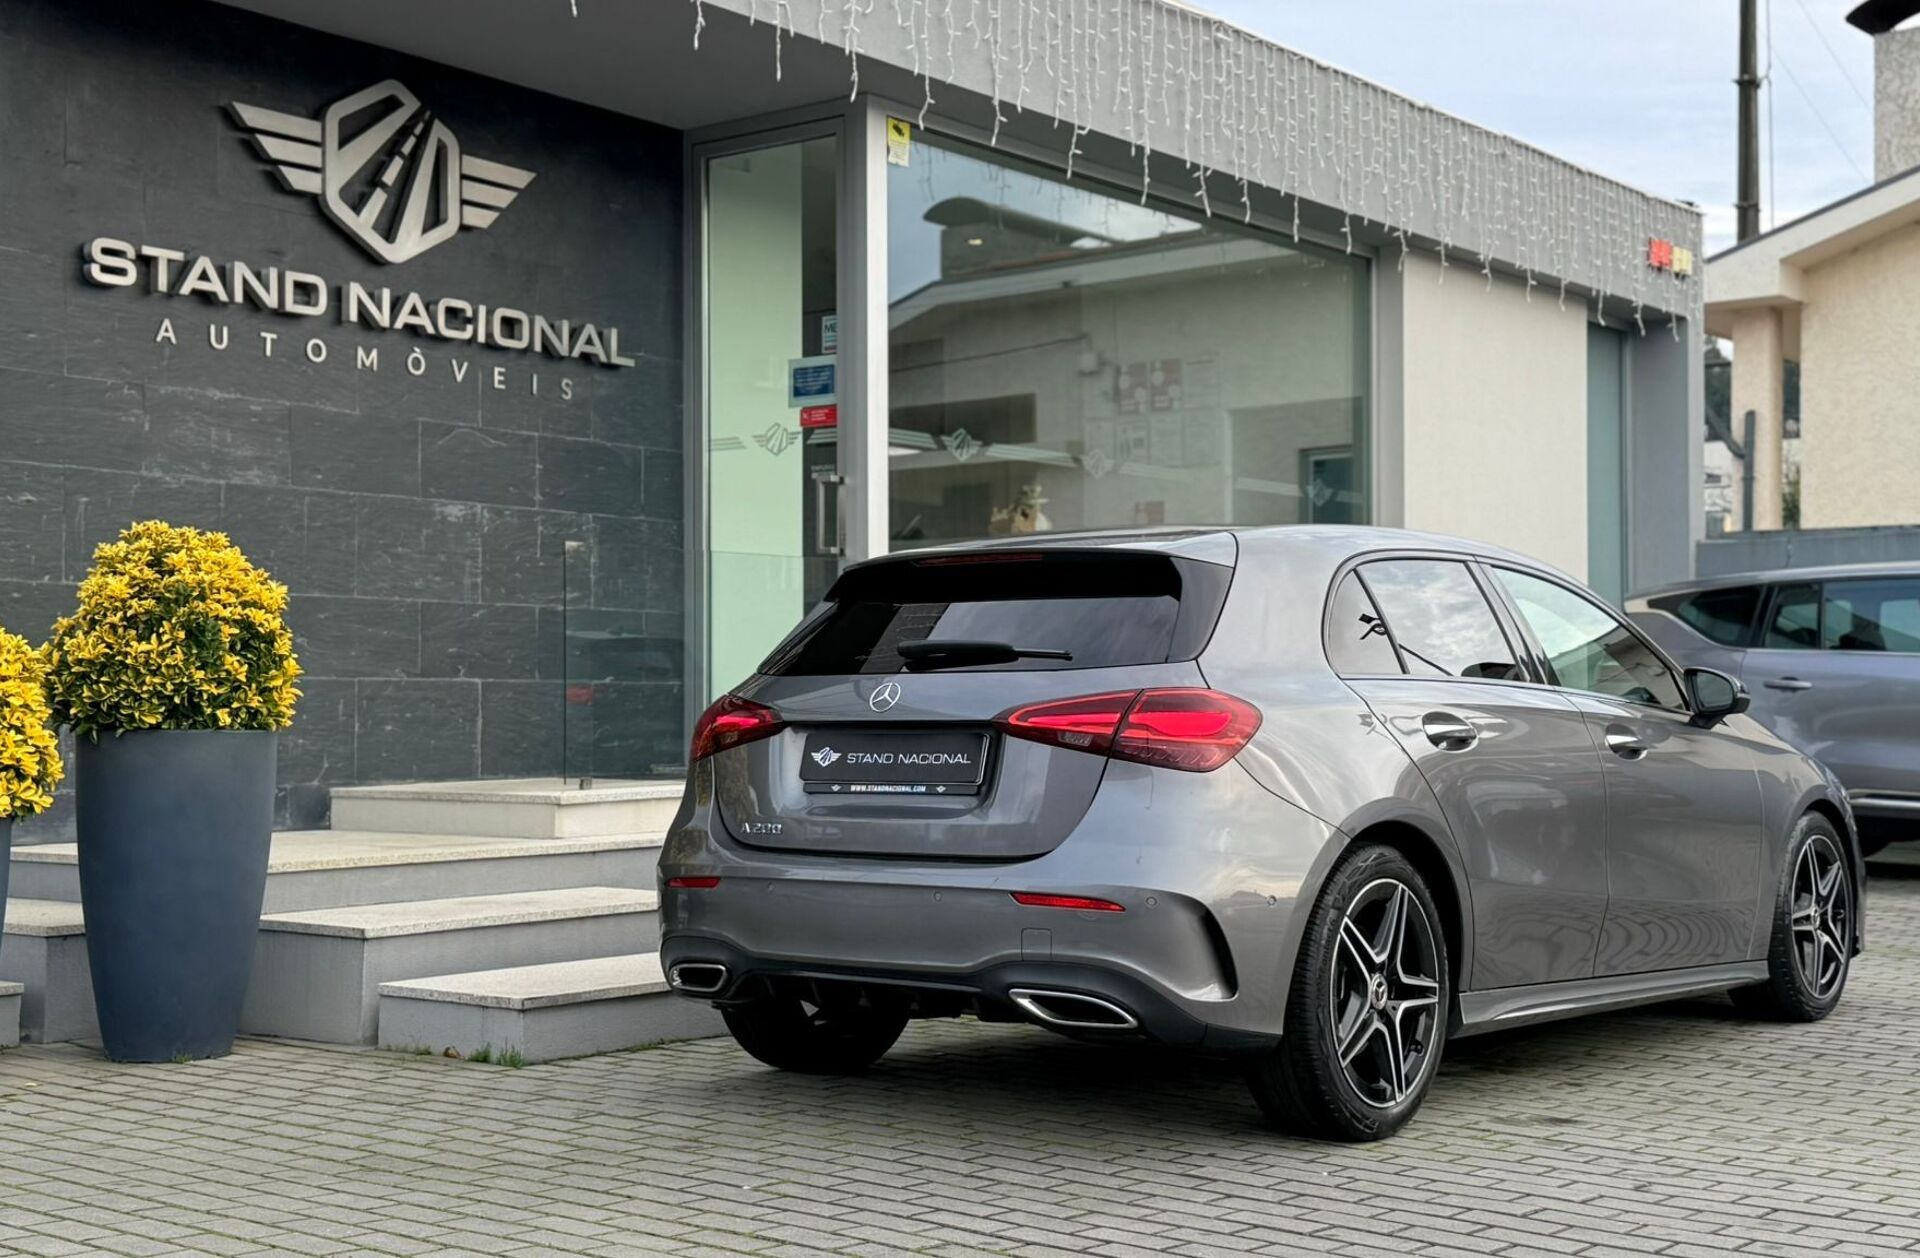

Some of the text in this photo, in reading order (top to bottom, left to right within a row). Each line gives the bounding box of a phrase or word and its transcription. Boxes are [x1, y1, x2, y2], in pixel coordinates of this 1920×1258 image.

[87, 237, 636, 368] STAND NACIONAL
[846, 752, 972, 764] STAND NACIONAL
[850, 784, 926, 792] WWW.STANDNACIONAL.COM
